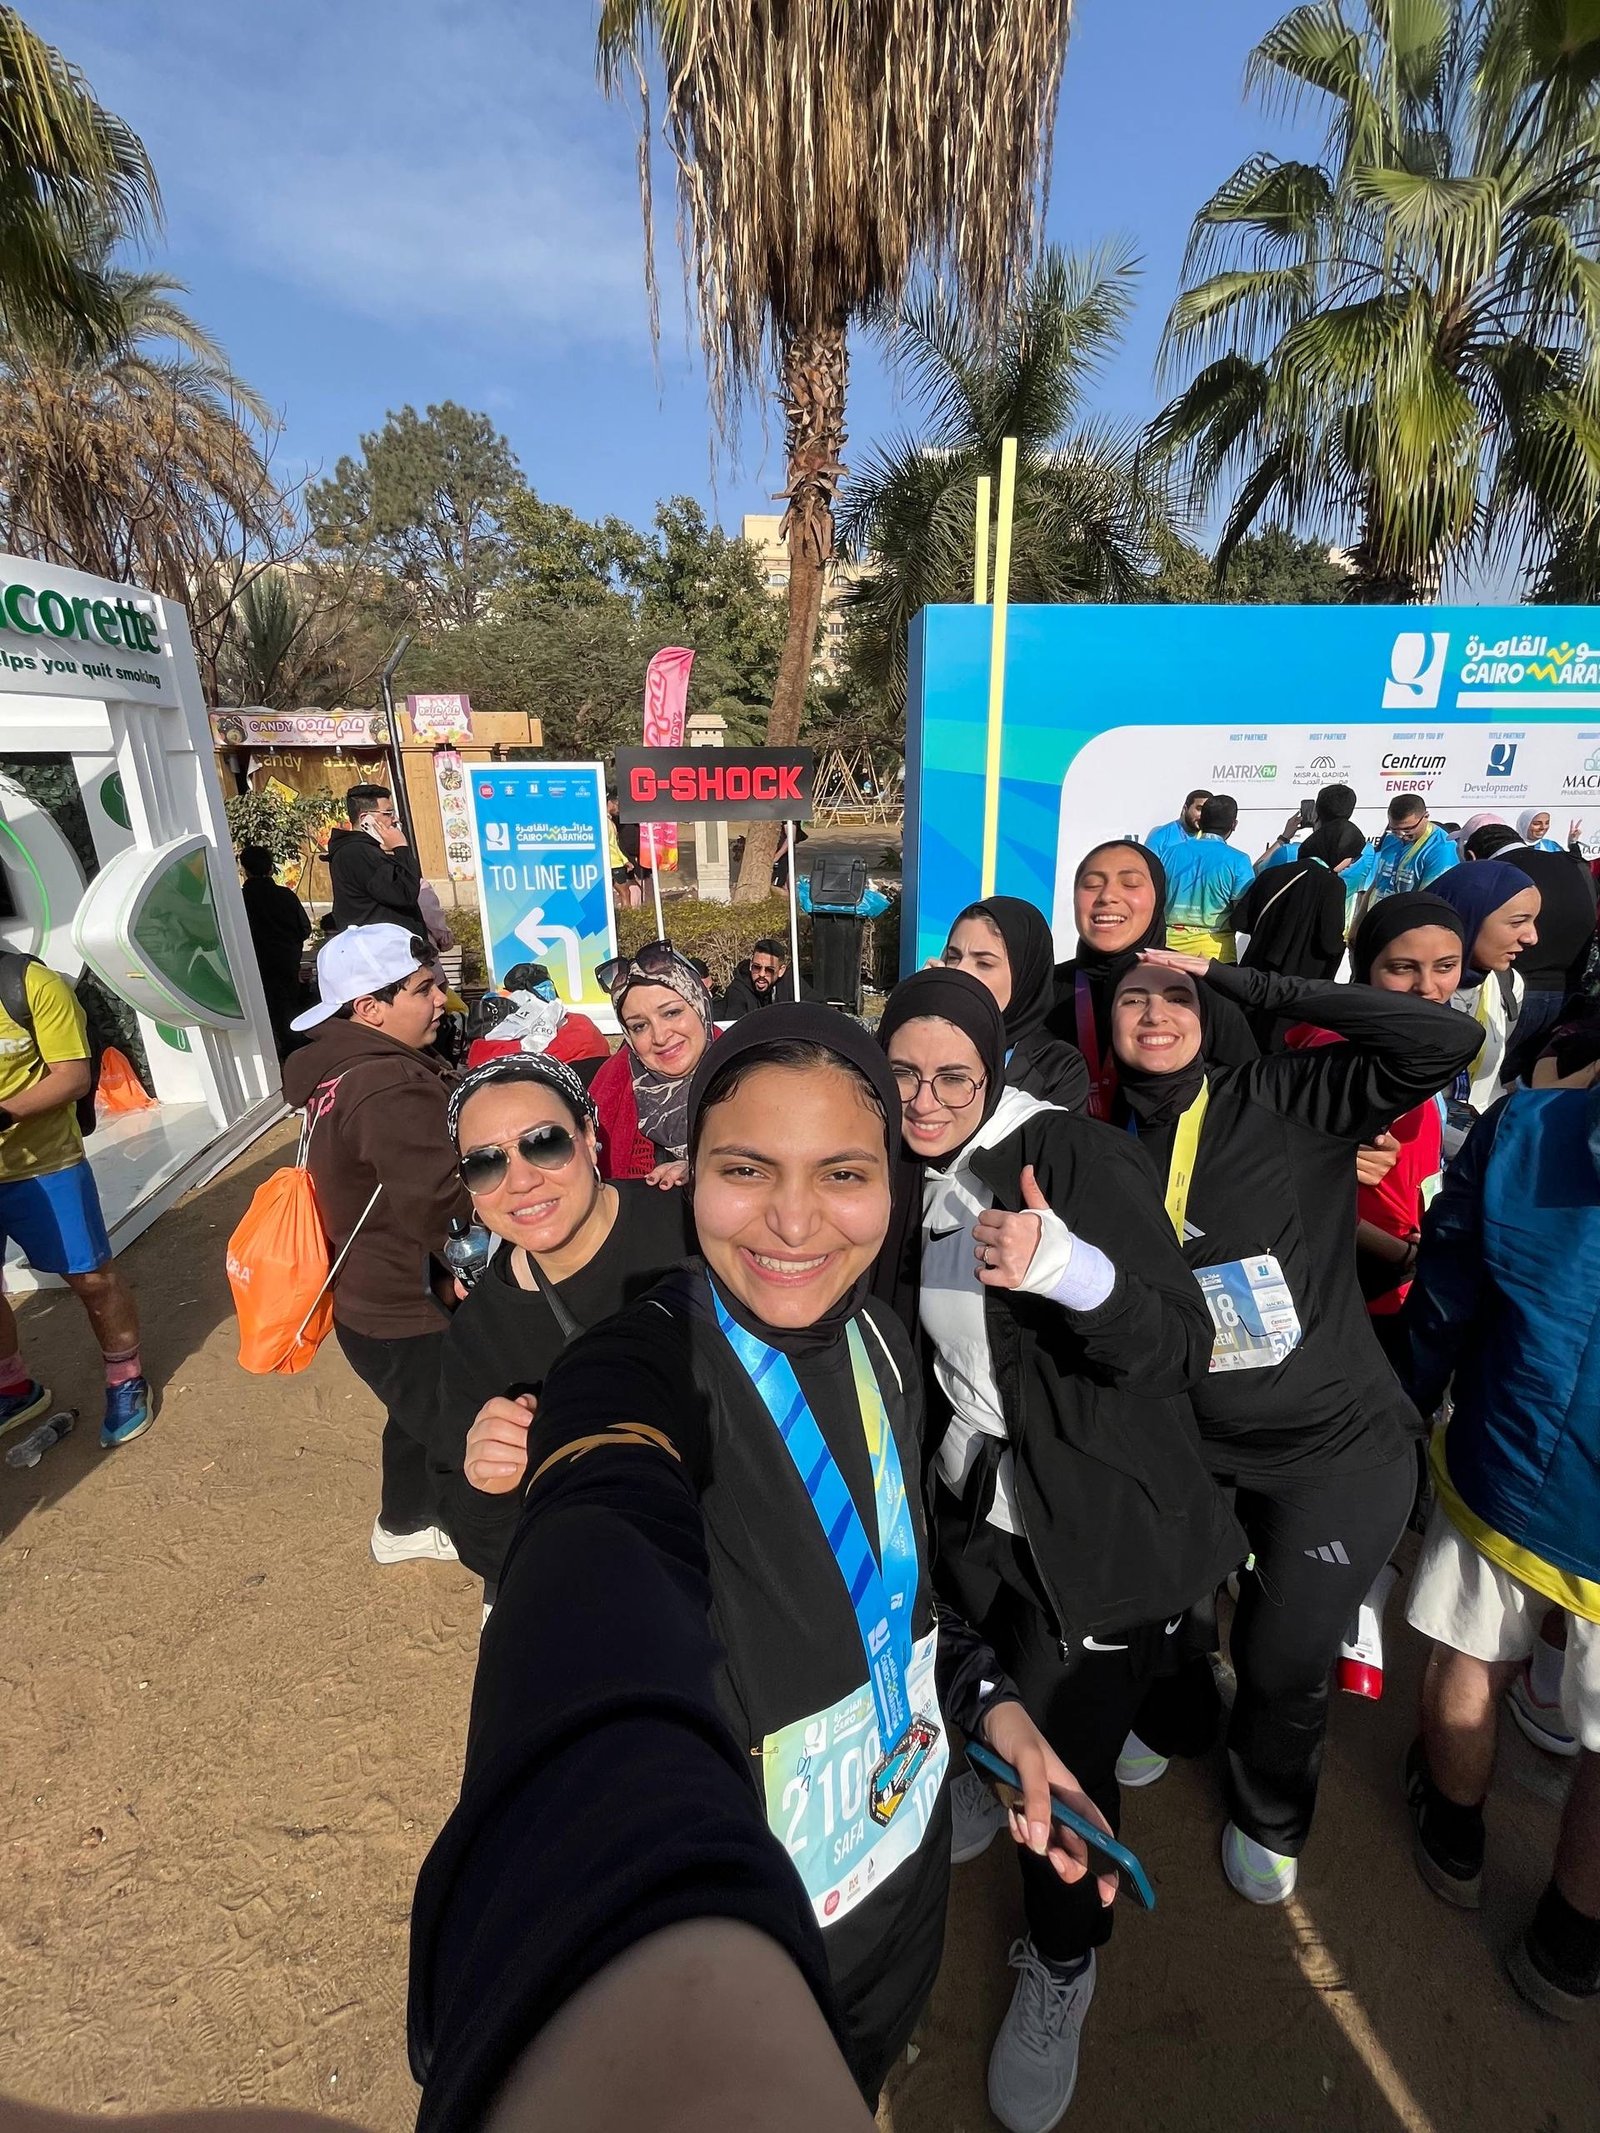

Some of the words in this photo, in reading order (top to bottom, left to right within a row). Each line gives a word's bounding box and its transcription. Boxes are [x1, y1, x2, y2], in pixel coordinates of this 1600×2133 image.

[1464, 635, 1548, 662] القاهرة
[41, 657, 77, 675] you
[82, 663, 114, 680] quit
[115, 668, 161, 689] smoking
[1460, 663, 1525, 684] CAIRO
[250, 720, 293, 732] CANDY
[1381, 753, 1446, 769] Centrum
[630, 766, 804, 801] G-SHOCK
[1386, 780, 1434, 792] ENERGY
[1463, 782, 1529, 794] Developments
[516, 833, 543, 841] CAIRO
[490, 865, 517, 891] TO
[522, 865, 568, 891] LINE
[572, 864, 598, 890] UP
[833, 1817, 865, 1865] SAFA
